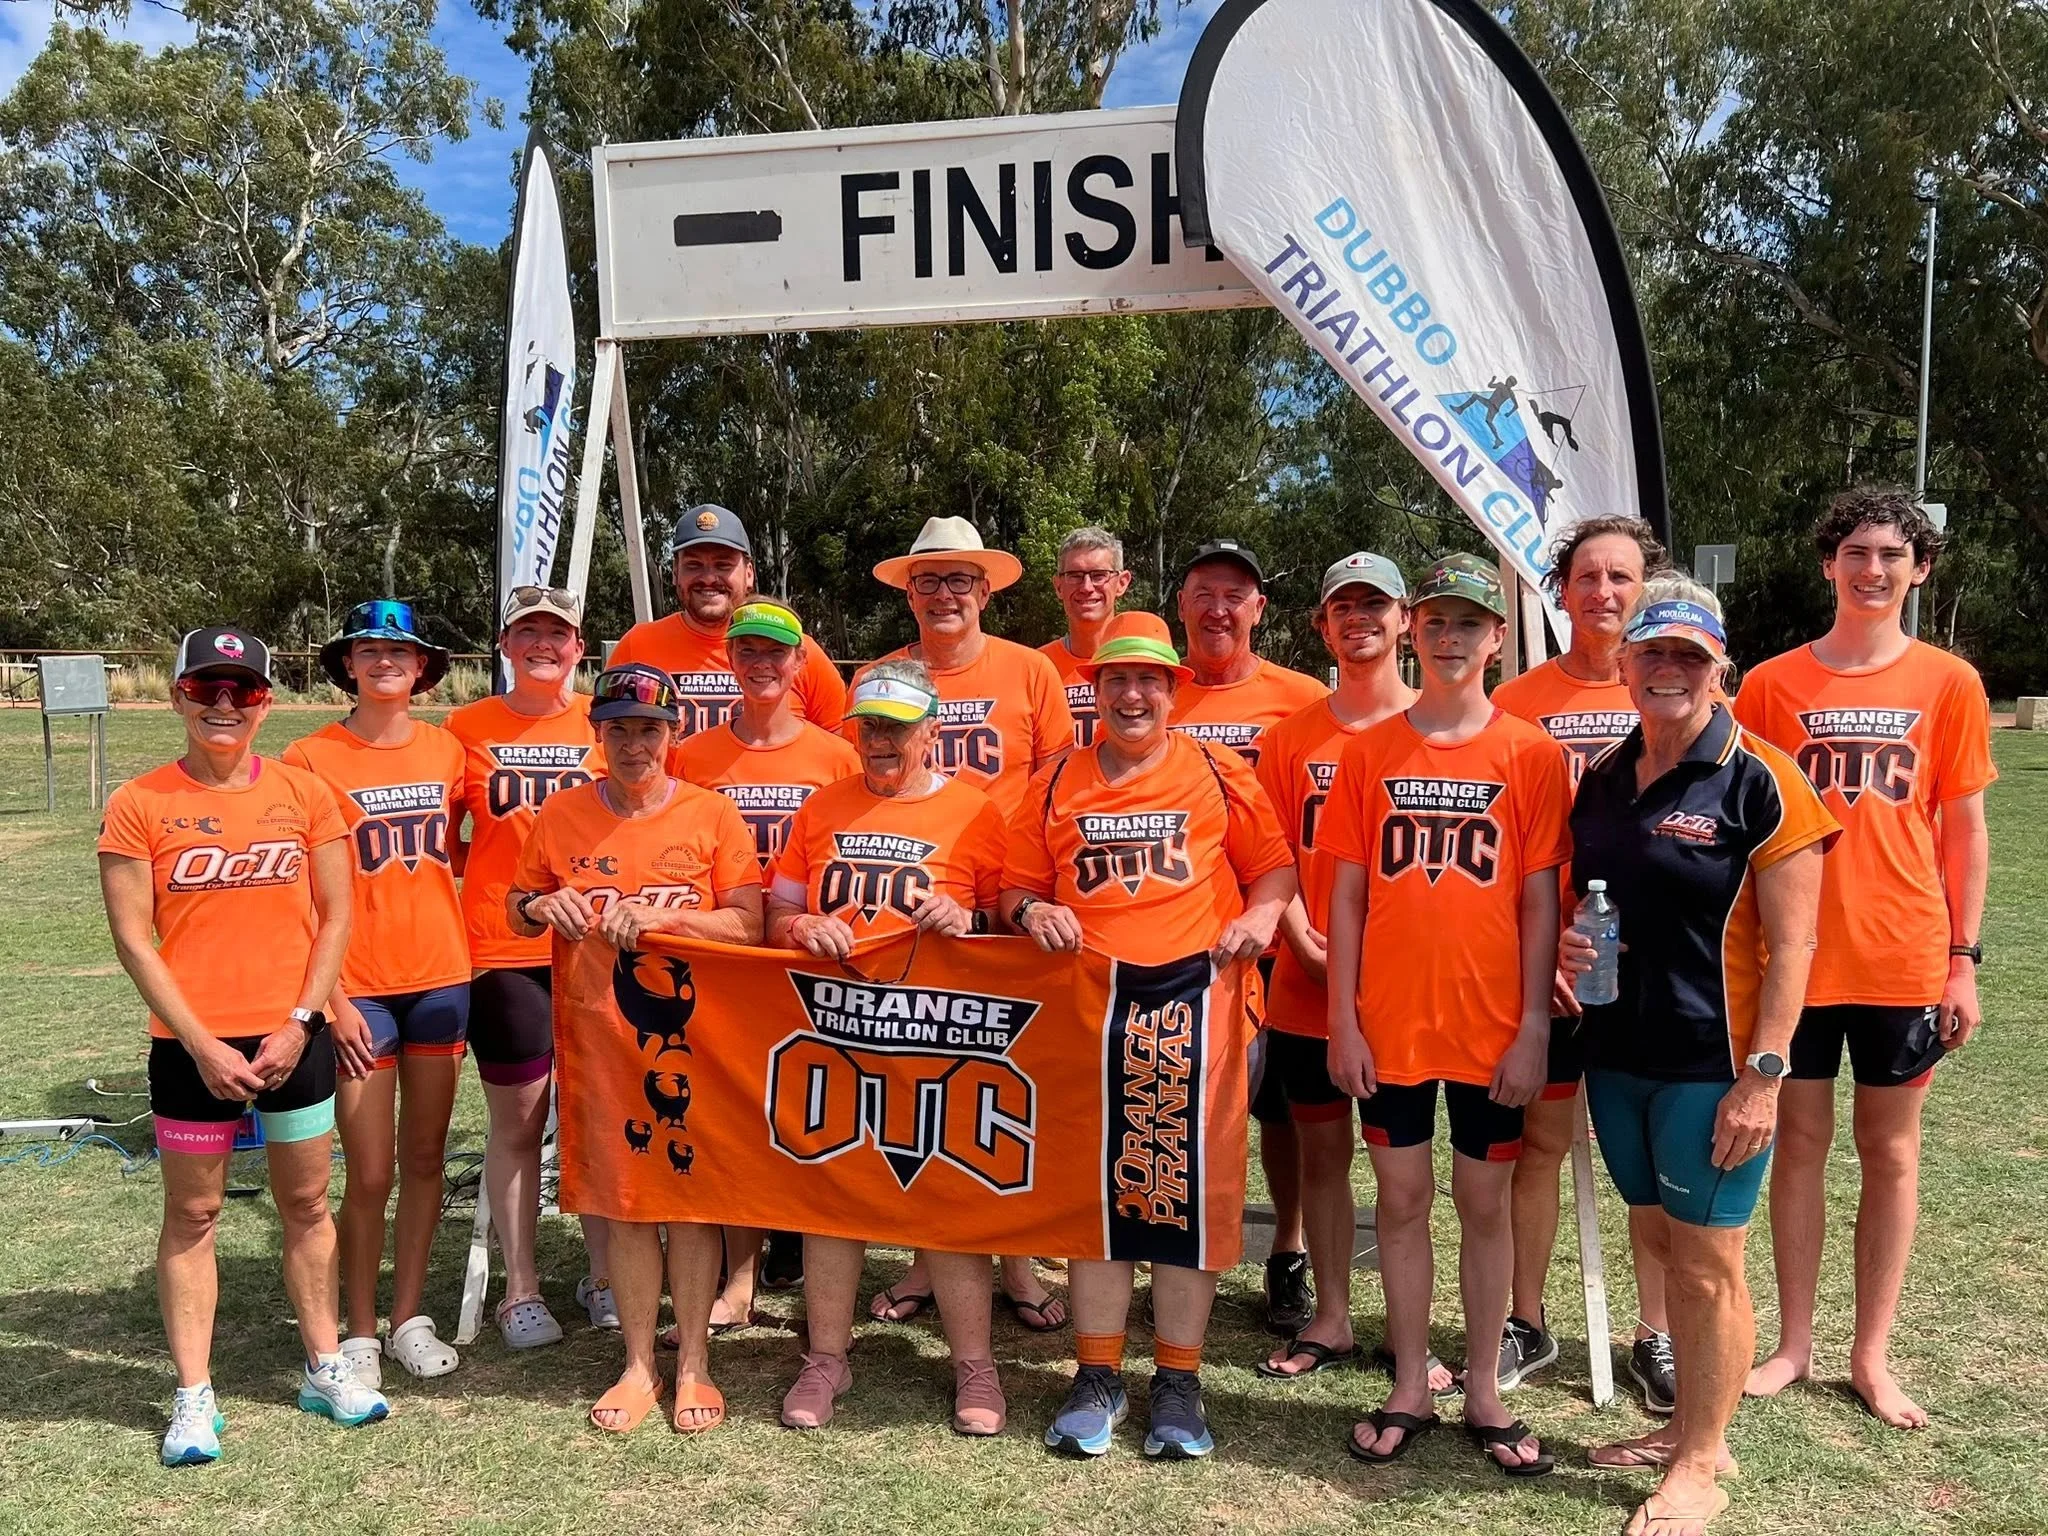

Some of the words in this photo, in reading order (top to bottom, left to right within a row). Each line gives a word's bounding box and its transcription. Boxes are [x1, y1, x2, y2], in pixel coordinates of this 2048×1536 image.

[1313, 196, 1458, 366] DUBBO
[1264, 233, 1485, 488] TRIATHLON
[1480, 489, 1553, 577] CLU
[680, 674, 739, 686] ORAN
[937, 702, 986, 715] ANGE
[961, 713, 985, 722] CLUB
[1549, 713, 1641, 729] ORANGE
[1809, 711, 1907, 726] ORANGE
[1550, 726, 1608, 737] TRIATHLON
[1611, 726, 1635, 734] CLU
[1809, 724, 1872, 736] TRIATHLON
[1875, 725, 1905, 736] CLUB
[1225, 736, 1251, 744] CLUB
[498, 747, 580, 759] ORANGE
[500, 757, 553, 765] TRIATHLON
[555, 757, 580, 765] CLUB
[923, 728, 1001, 778] TC
[1797, 741, 1917, 806] OTC
[361, 785, 441, 804] ORANGE
[724, 787, 803, 800] ORANGE
[1394, 781, 1491, 799] ORANGE
[364, 801, 418, 813] TRIATHLON
[420, 798, 442, 806] CLUB
[735, 799, 775, 807] IATHLON
[777, 799, 802, 807] CLUB
[1394, 796, 1454, 807] TRIATHLON
[1456, 799, 1488, 809] CLUB
[1085, 815, 1177, 831] ORANGE
[1086, 830, 1146, 841] TRIATHLON
[842, 835, 925, 855] ORANGE
[1380, 814, 1499, 886] OTC
[841, 847, 892, 857] TRIATHLON
[894, 852, 922, 861] CLUB
[170, 840, 303, 885] OcTc
[1074, 831, 1192, 896] OTC
[170, 883, 206, 891] Orange
[819, 861, 931, 920] OTC
[813, 981, 1012, 1029] ORANGE
[813, 1008, 938, 1042] TRIATHLON
[946, 1027, 1009, 1047] CLUB
[1114, 1001, 1160, 1194] ORANGE
[764, 1029, 1037, 1196] OTC
[1149, 1000, 1192, 1231] PIRANHAS
[163, 1130, 225, 1142] GARMIN
